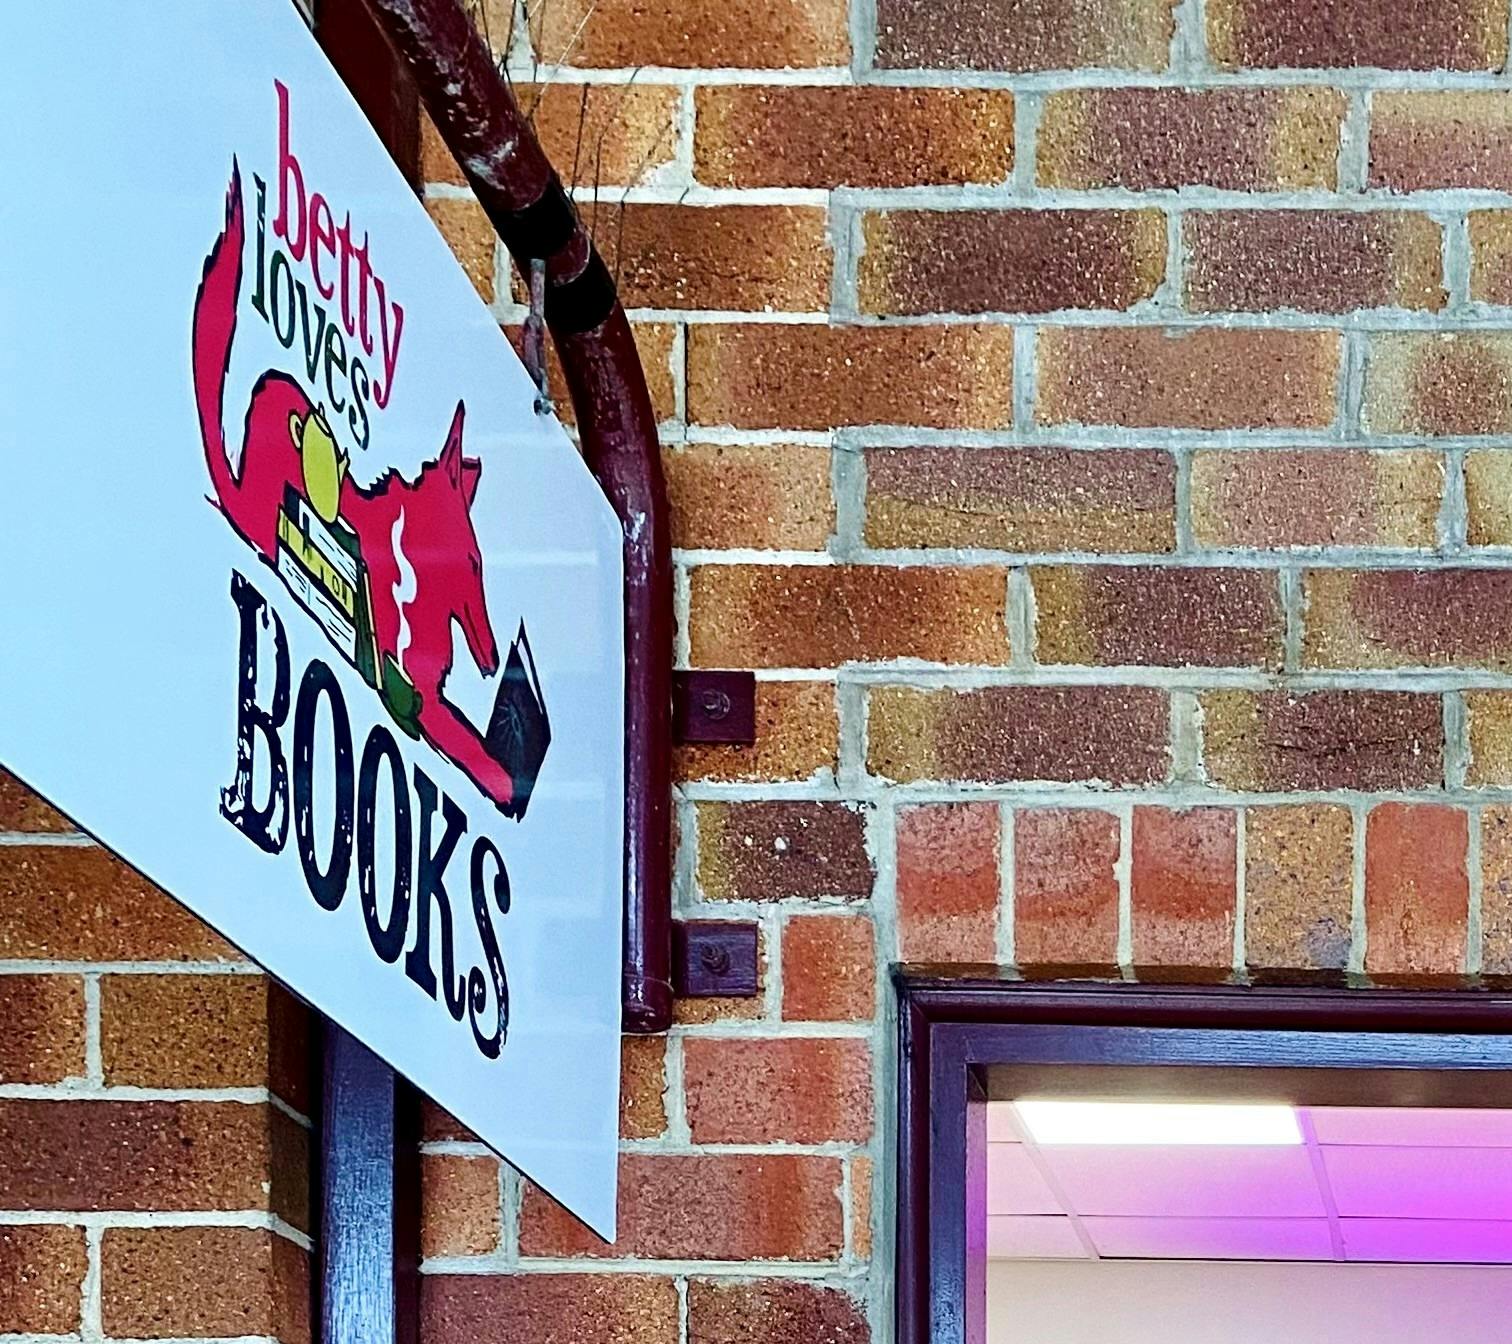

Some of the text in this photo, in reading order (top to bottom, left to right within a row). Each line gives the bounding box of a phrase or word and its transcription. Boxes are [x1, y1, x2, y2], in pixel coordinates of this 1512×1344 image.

[251, 172, 372, 451] loves
[273, 78, 404, 411] betty
[218, 567, 513, 1061] BOOKS
